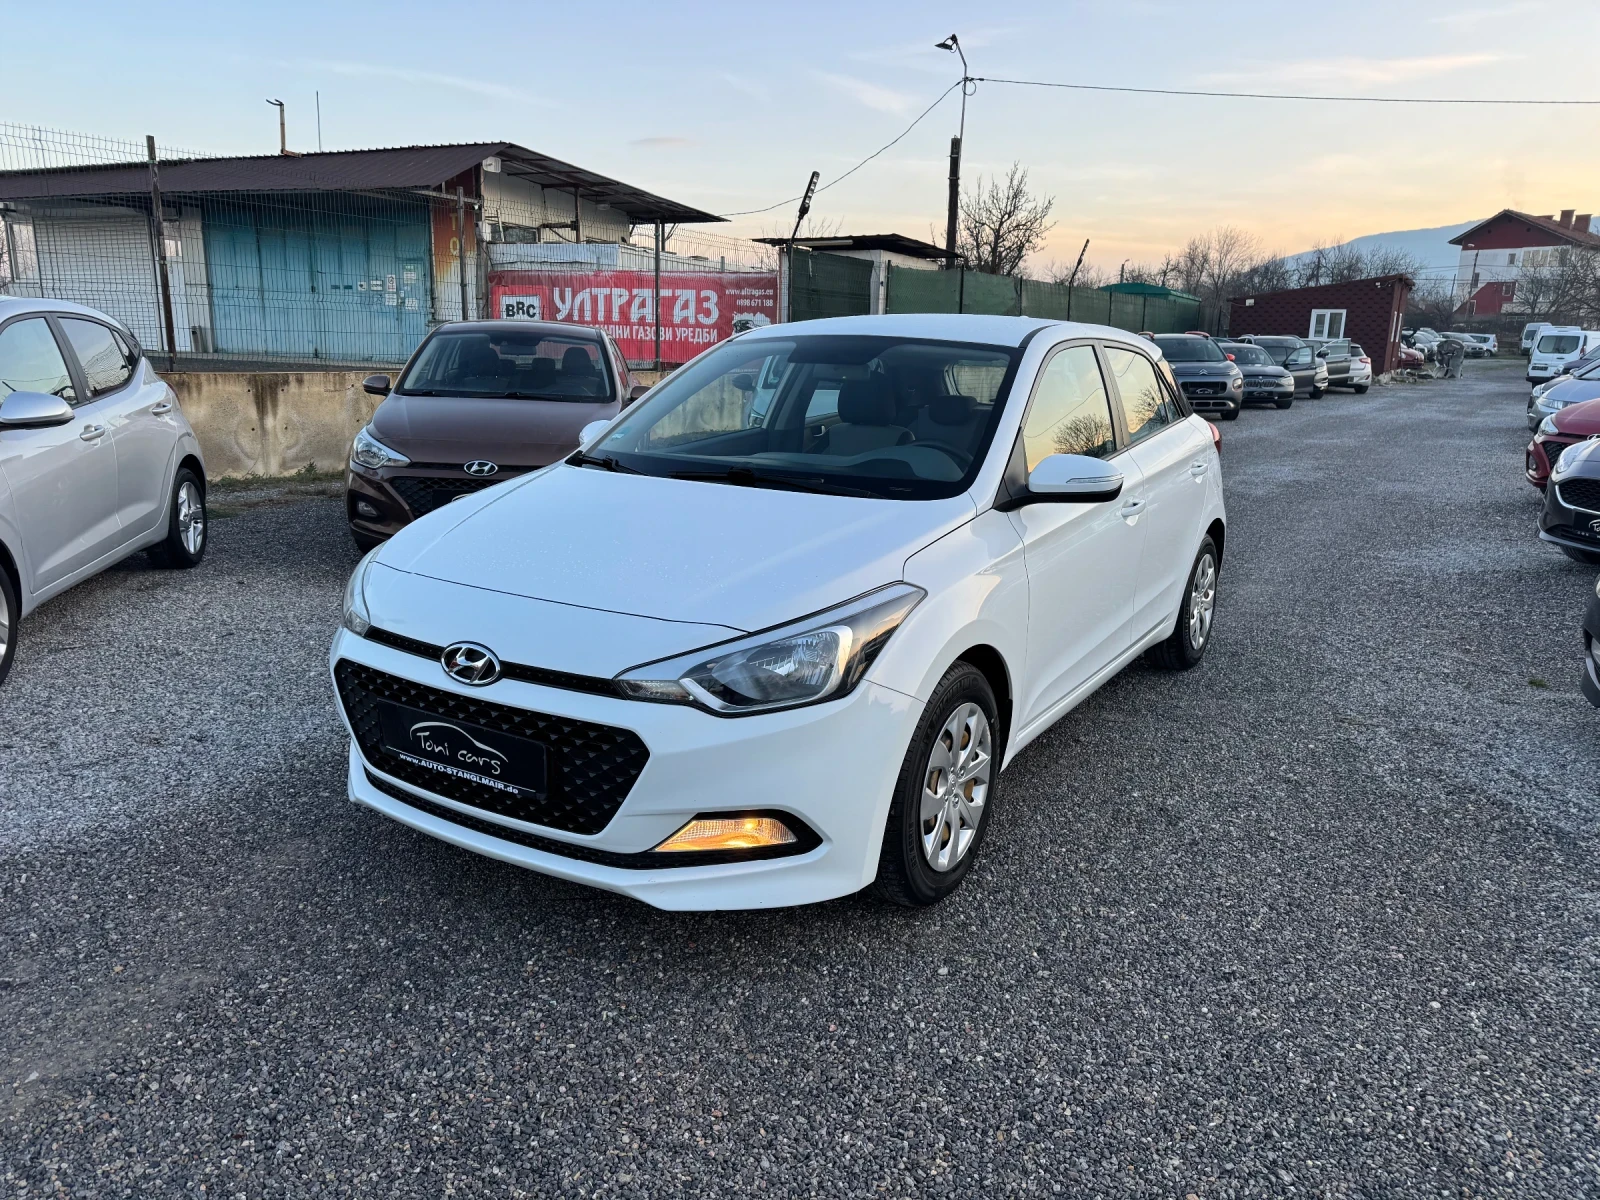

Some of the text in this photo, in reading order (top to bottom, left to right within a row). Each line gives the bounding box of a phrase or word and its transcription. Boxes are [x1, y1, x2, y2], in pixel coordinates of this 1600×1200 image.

[505, 301, 537, 319] BRC
[552, 286, 720, 326] УЛТРАГАЗ
[675, 327, 718, 345] УРЕДБИ
[416, 731, 501, 775] Toni cars
